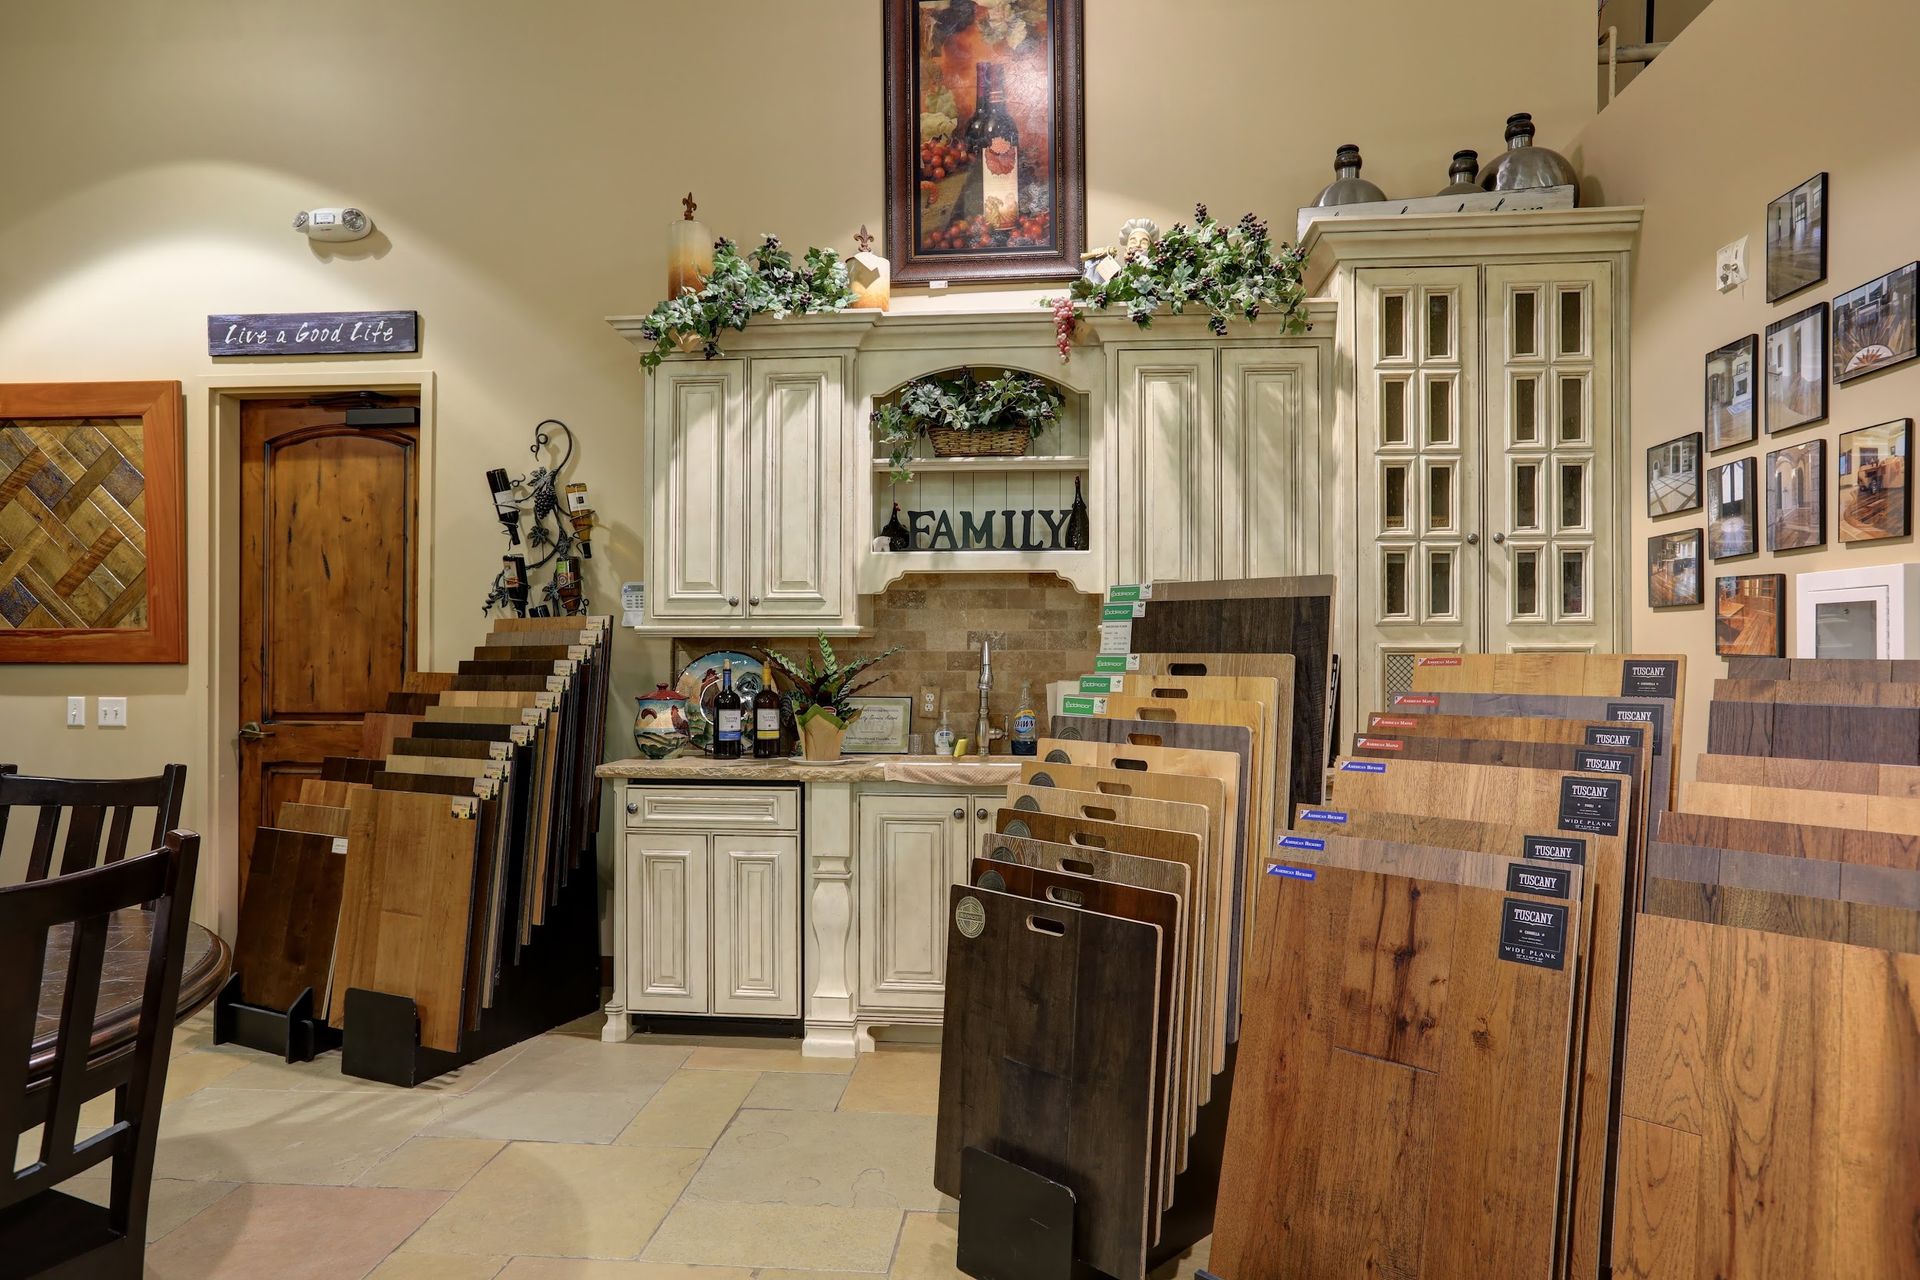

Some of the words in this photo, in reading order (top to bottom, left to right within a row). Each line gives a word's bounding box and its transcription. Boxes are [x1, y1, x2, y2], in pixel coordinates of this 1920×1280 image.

[224, 324, 267, 344] Live
[276, 330, 287, 343] a
[295, 322, 343, 342] Good
[350, 320, 394, 342] Life
[908, 509, 1074, 549] FAMILY
[1632, 667, 1666, 676] TUSCANY
[1617, 711, 1652, 720] TUSCANY
[1595, 734, 1631, 745] TUSCANY
[1586, 758, 1622, 770] TUSCANY
[1572, 785, 1609, 797] TUSCANY
[1535, 845, 1572, 858] TUSCANY
[1519, 873, 1557, 889] TUSCANY
[1514, 908, 1554, 925] TUSCANY
[1504, 945, 1526, 954] WIDE
[1529, 950, 1556, 960] PLANK
